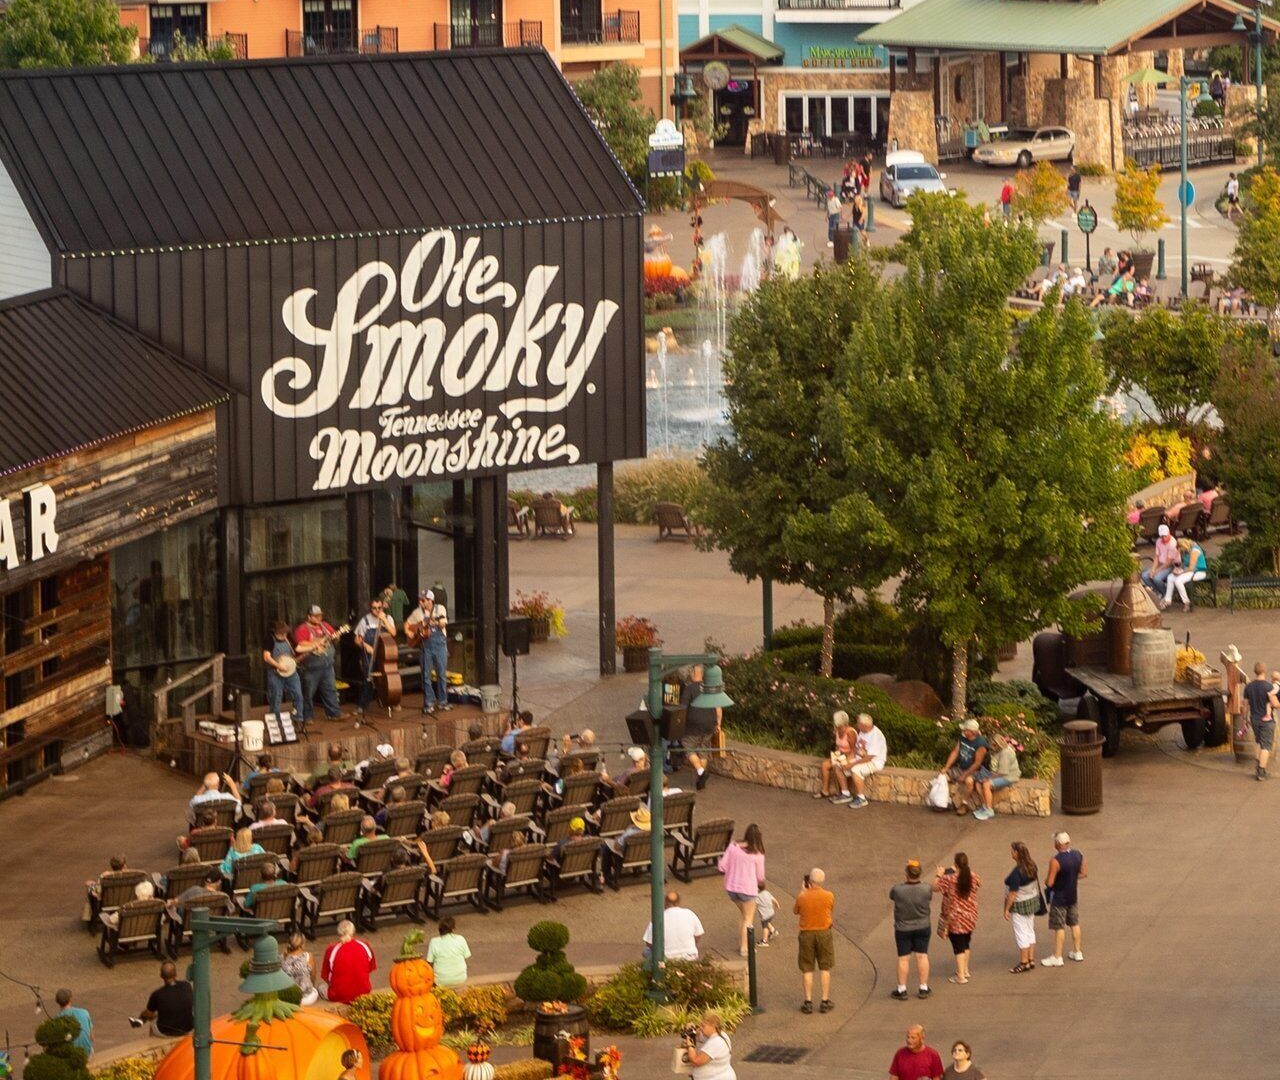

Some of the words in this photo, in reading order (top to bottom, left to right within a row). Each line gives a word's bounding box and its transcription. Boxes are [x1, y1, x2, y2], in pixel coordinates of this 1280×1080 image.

[400, 229, 518, 313] Ole
[308, 415, 581, 491] Moonshine
[378, 405, 483, 439] Tennessee
